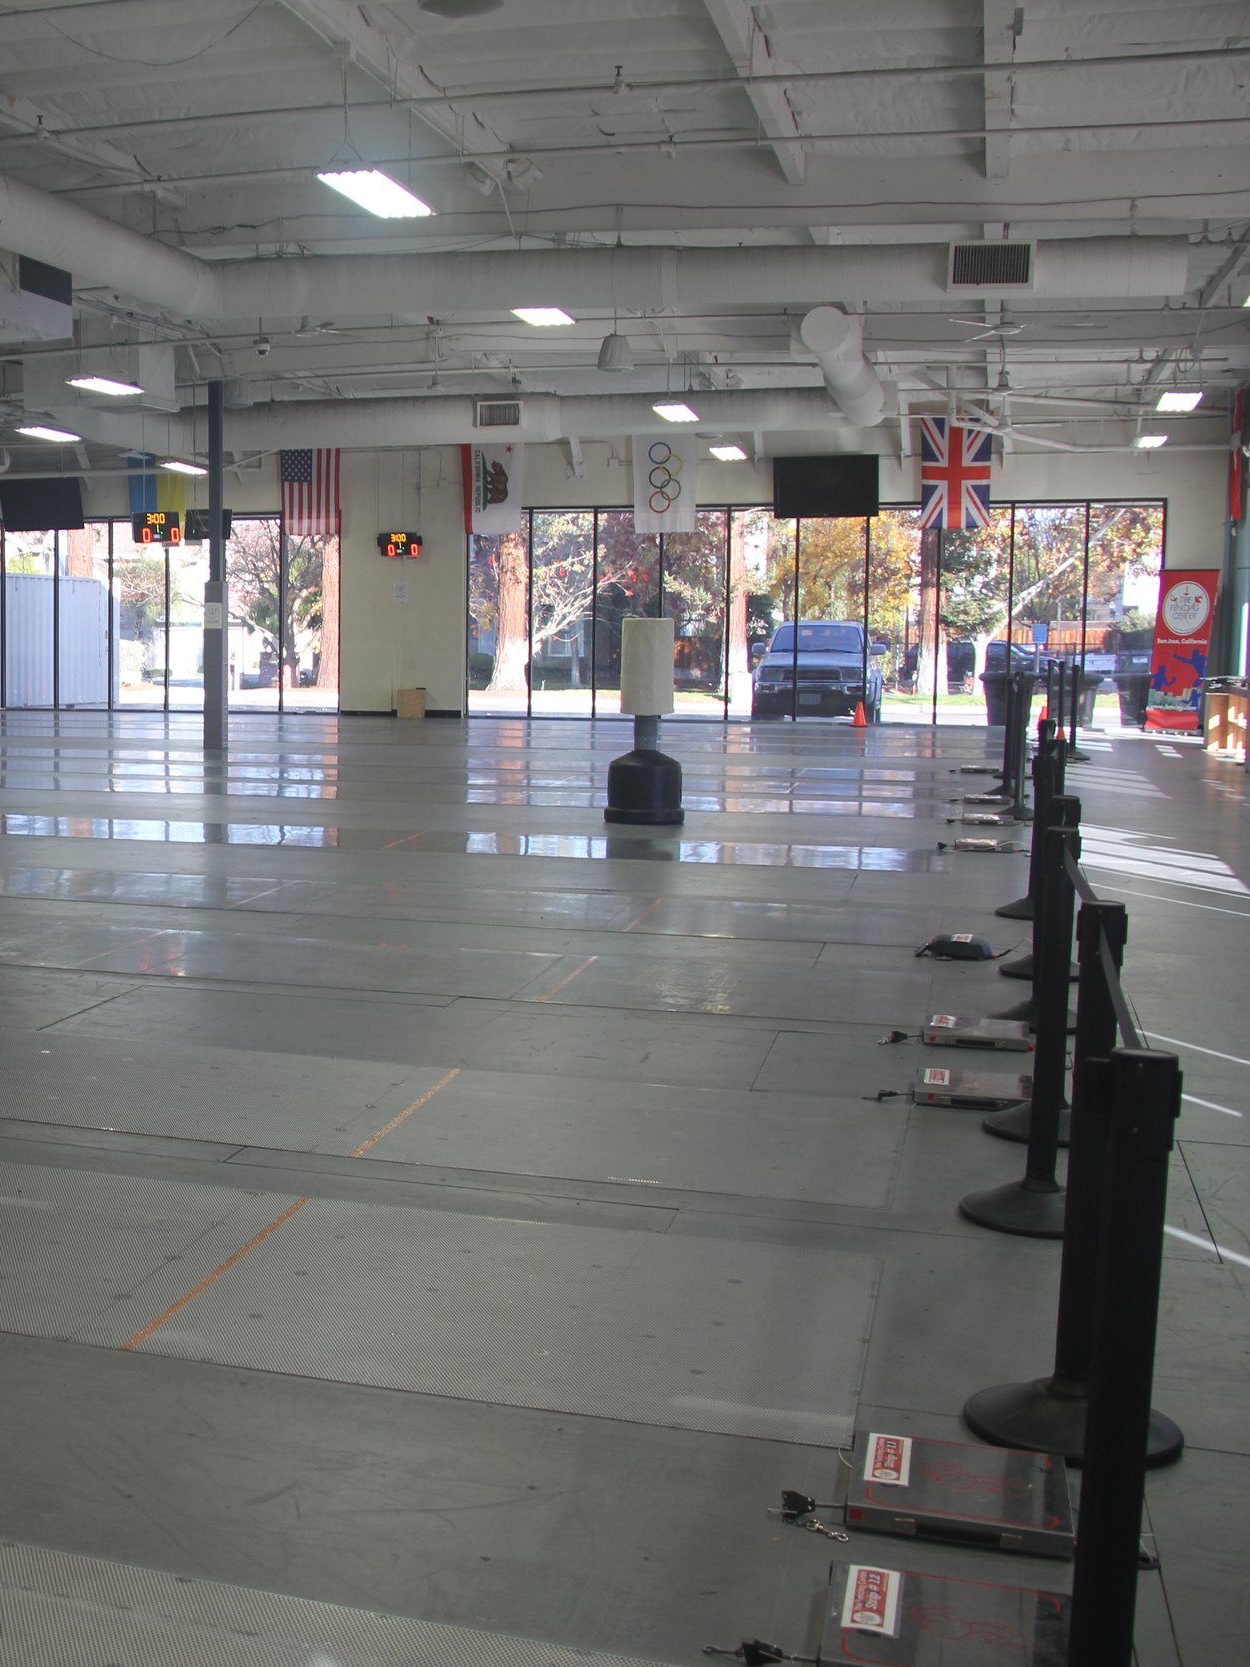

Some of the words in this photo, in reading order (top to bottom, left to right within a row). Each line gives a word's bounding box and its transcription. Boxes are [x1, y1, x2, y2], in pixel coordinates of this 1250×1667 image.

[146, 513, 166, 524] 3:00
[142, 527, 152, 543] 0
[171, 527, 180, 543] 0
[390, 533, 407, 543] 3:00
[387, 544, 396, 557] 0
[410, 543, 419, 556] 0
[1180, 595, 1192, 603] THE
[1170, 604, 1199, 612] FENCING
[1172, 611, 1197, 620] CENTER
[886, 1440, 897, 1449] 11
[884, 1453, 898, 1468] Strip
[868, 1573, 881, 1584] 12
[865, 1591, 882, 1610] Strip
